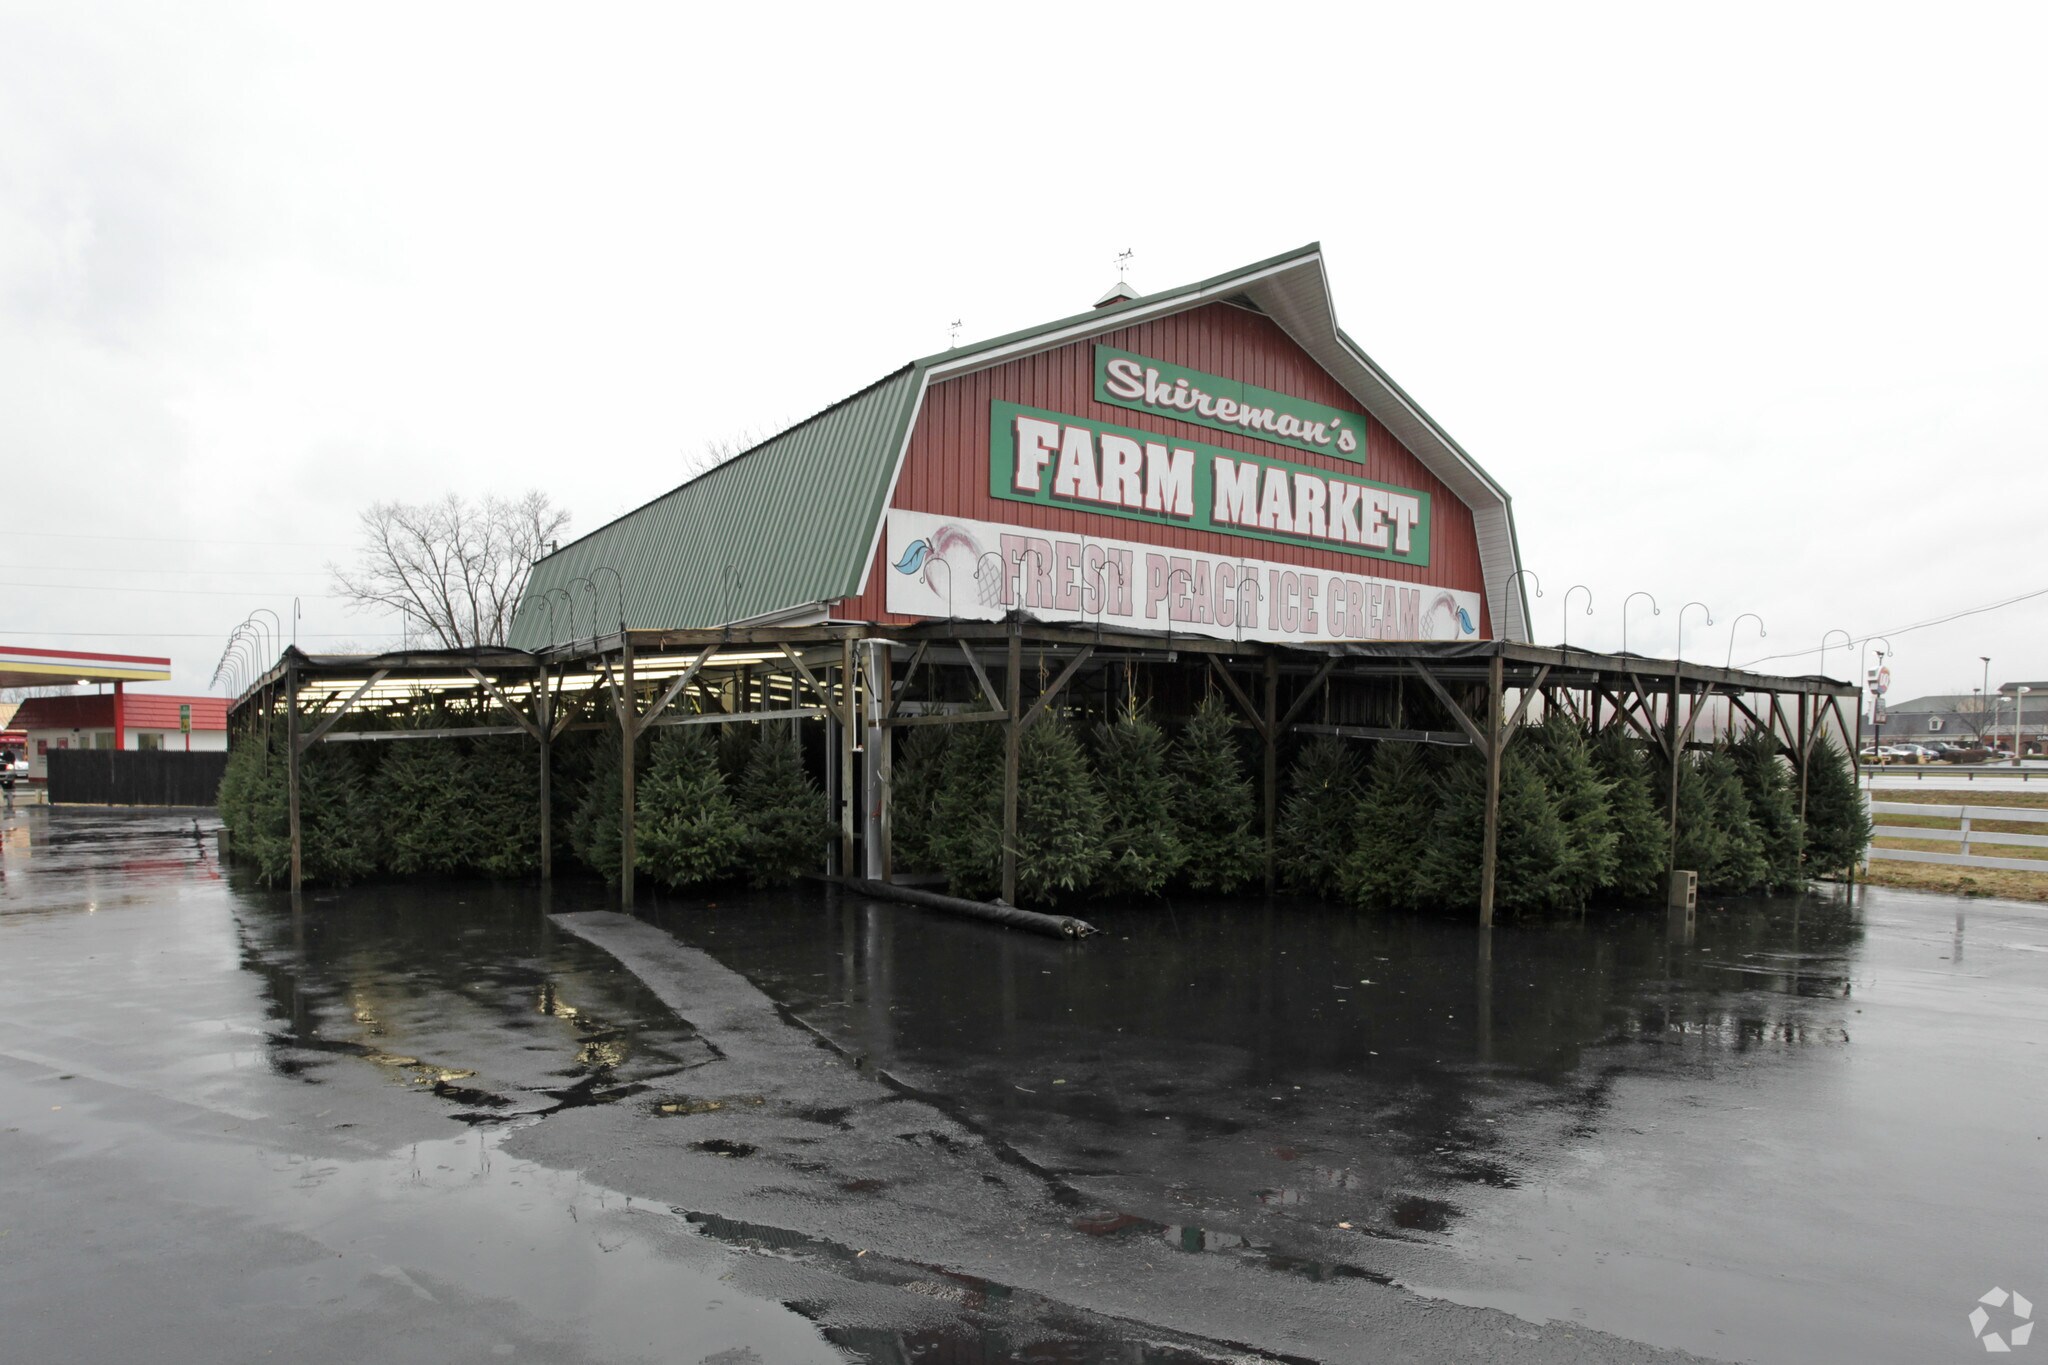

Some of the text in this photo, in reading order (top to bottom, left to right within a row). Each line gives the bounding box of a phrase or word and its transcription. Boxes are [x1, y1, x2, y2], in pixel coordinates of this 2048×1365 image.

[1105, 357, 1358, 455] Shireman's
[1015, 414, 1421, 554] FARM MARKET
[999, 533, 1421, 640] FRESH PEACH ICE CREAM
